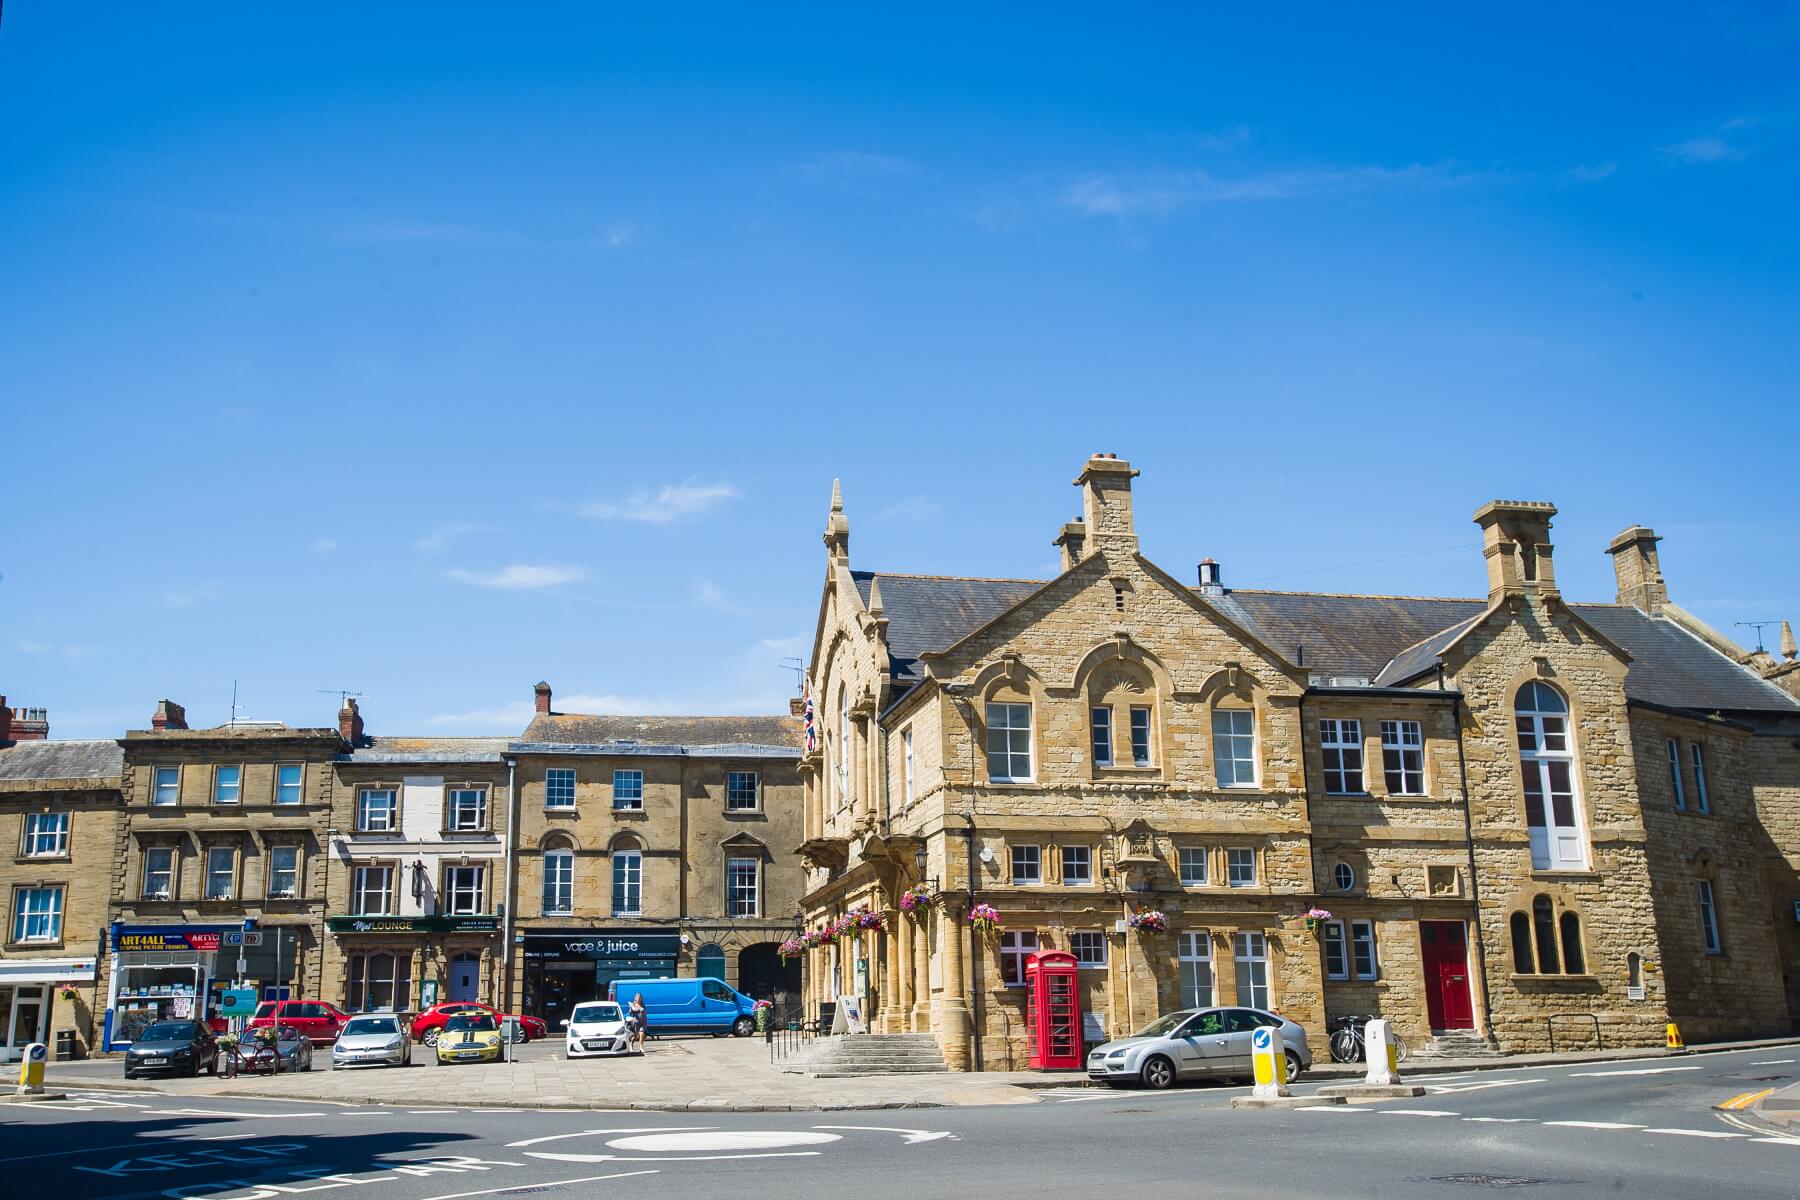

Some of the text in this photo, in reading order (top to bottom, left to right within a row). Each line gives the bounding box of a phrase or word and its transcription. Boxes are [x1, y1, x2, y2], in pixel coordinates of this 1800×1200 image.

[372, 921, 413, 930] LOUNGE
[120, 935, 166, 945] ART4ALL
[565, 939, 638, 954] vape & juice
[72, 1143, 308, 1177] KEEP
[161, 1155, 527, 1200] CLEAR
